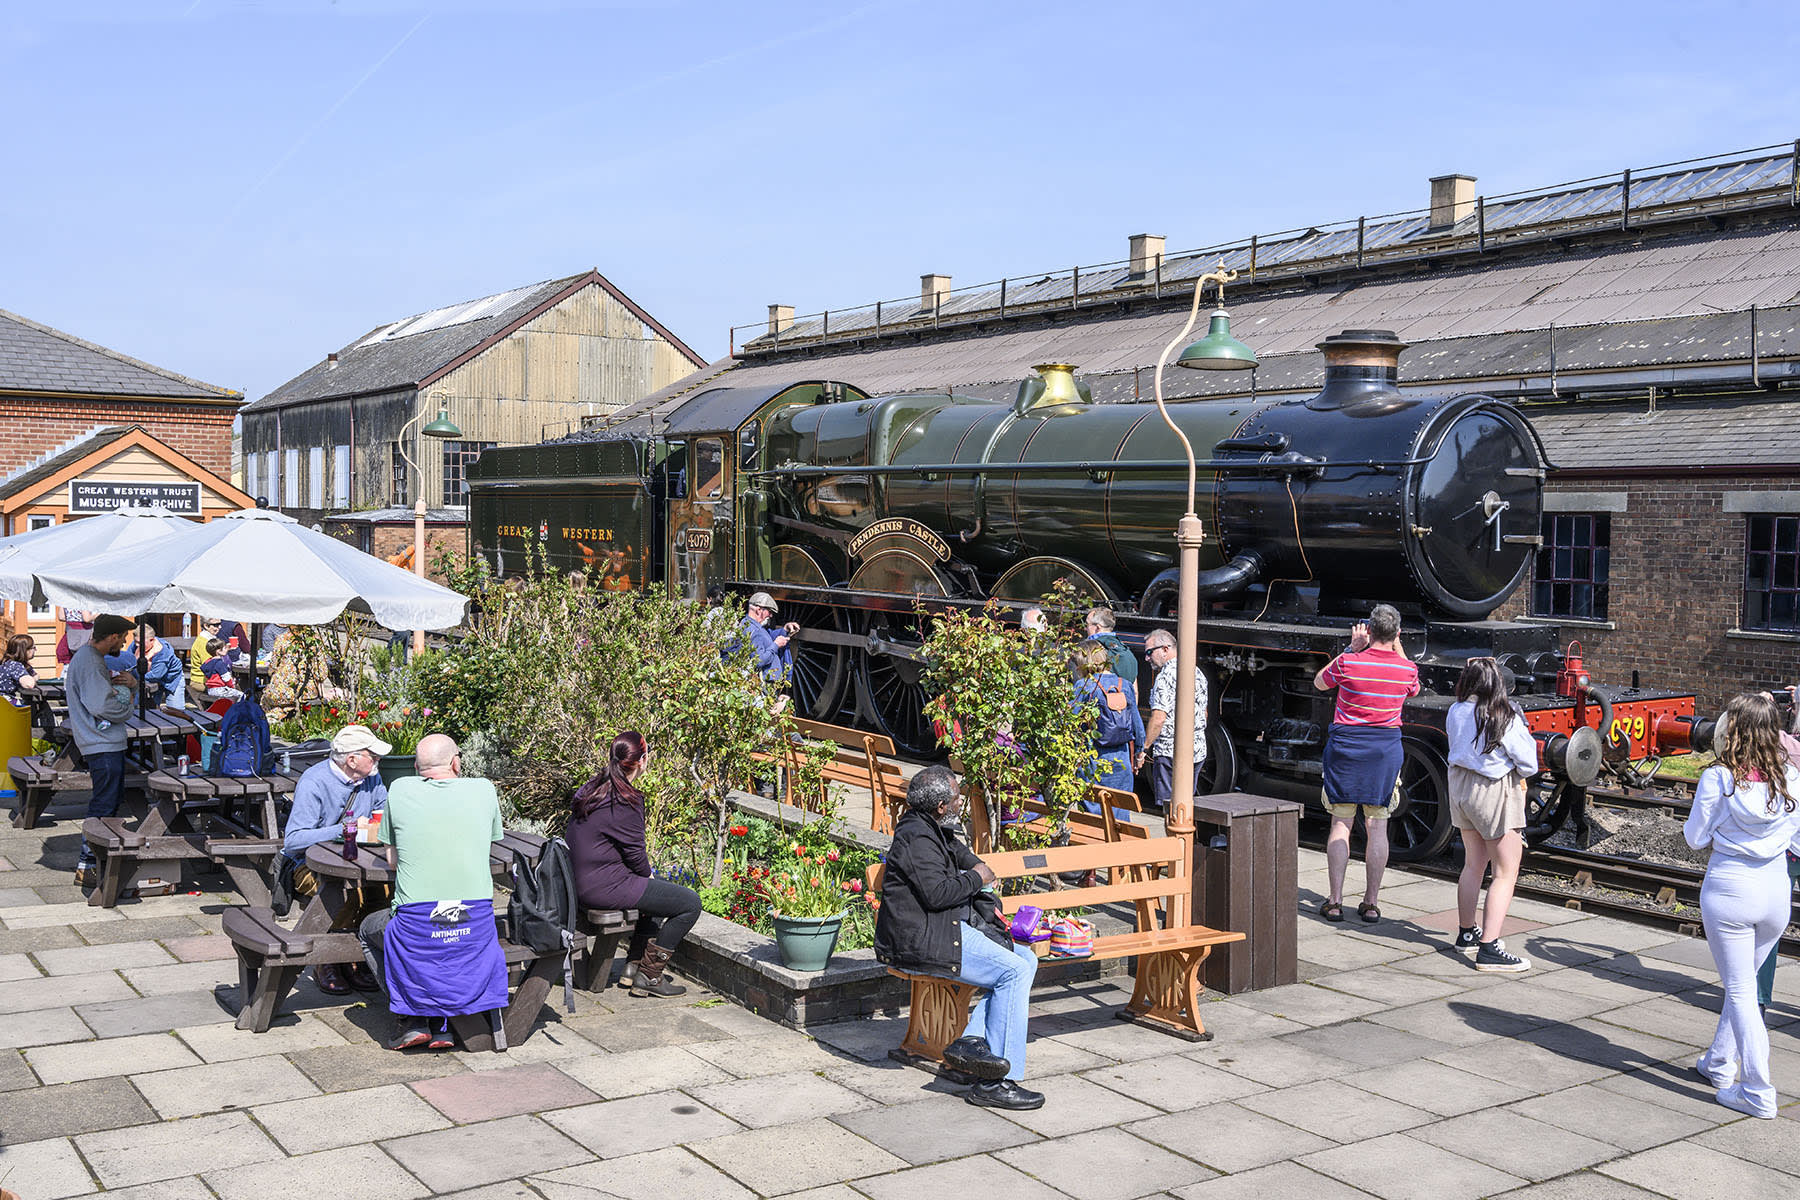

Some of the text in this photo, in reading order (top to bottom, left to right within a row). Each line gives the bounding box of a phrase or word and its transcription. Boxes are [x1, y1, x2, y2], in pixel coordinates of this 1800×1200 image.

[78, 487, 193, 496] GREAT WESTERN TRUST
[79, 498, 130, 507] MUSEUM
[562, 527, 613, 541] WESTERN
[687, 534, 710, 548] 4079
[851, 521, 946, 556] PENDENNIS CASTLE
[431, 928, 471, 938] ANTIMATTER
[920, 983, 958, 1045] GWR
